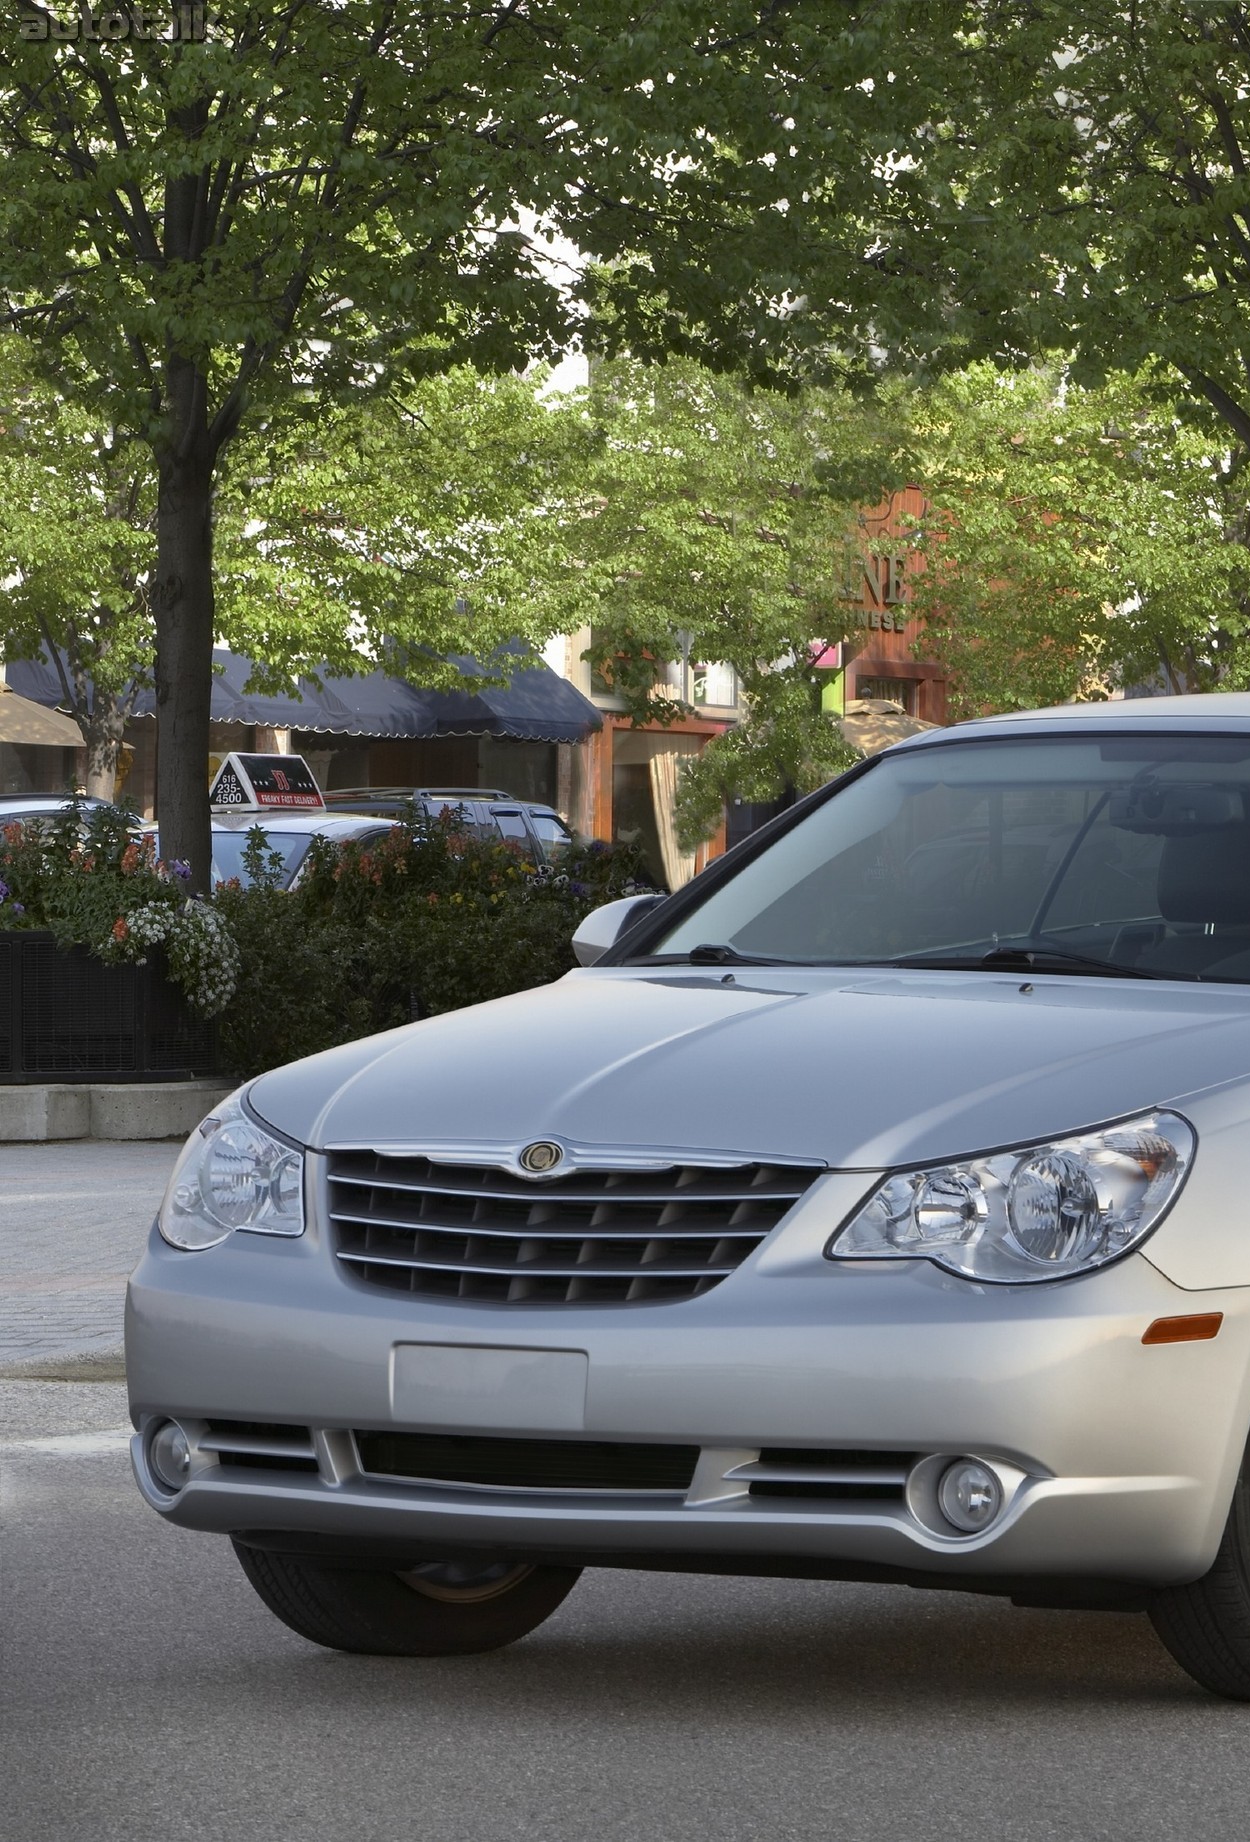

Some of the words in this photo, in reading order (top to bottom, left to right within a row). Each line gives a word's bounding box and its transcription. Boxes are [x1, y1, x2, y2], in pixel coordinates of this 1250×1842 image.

[222, 774, 237, 784] 616
[217, 783, 241, 794] 235-
[215, 792, 242, 804] 4500
[261, 794, 280, 804] FREAKY
[280, 795, 294, 805] FAST
